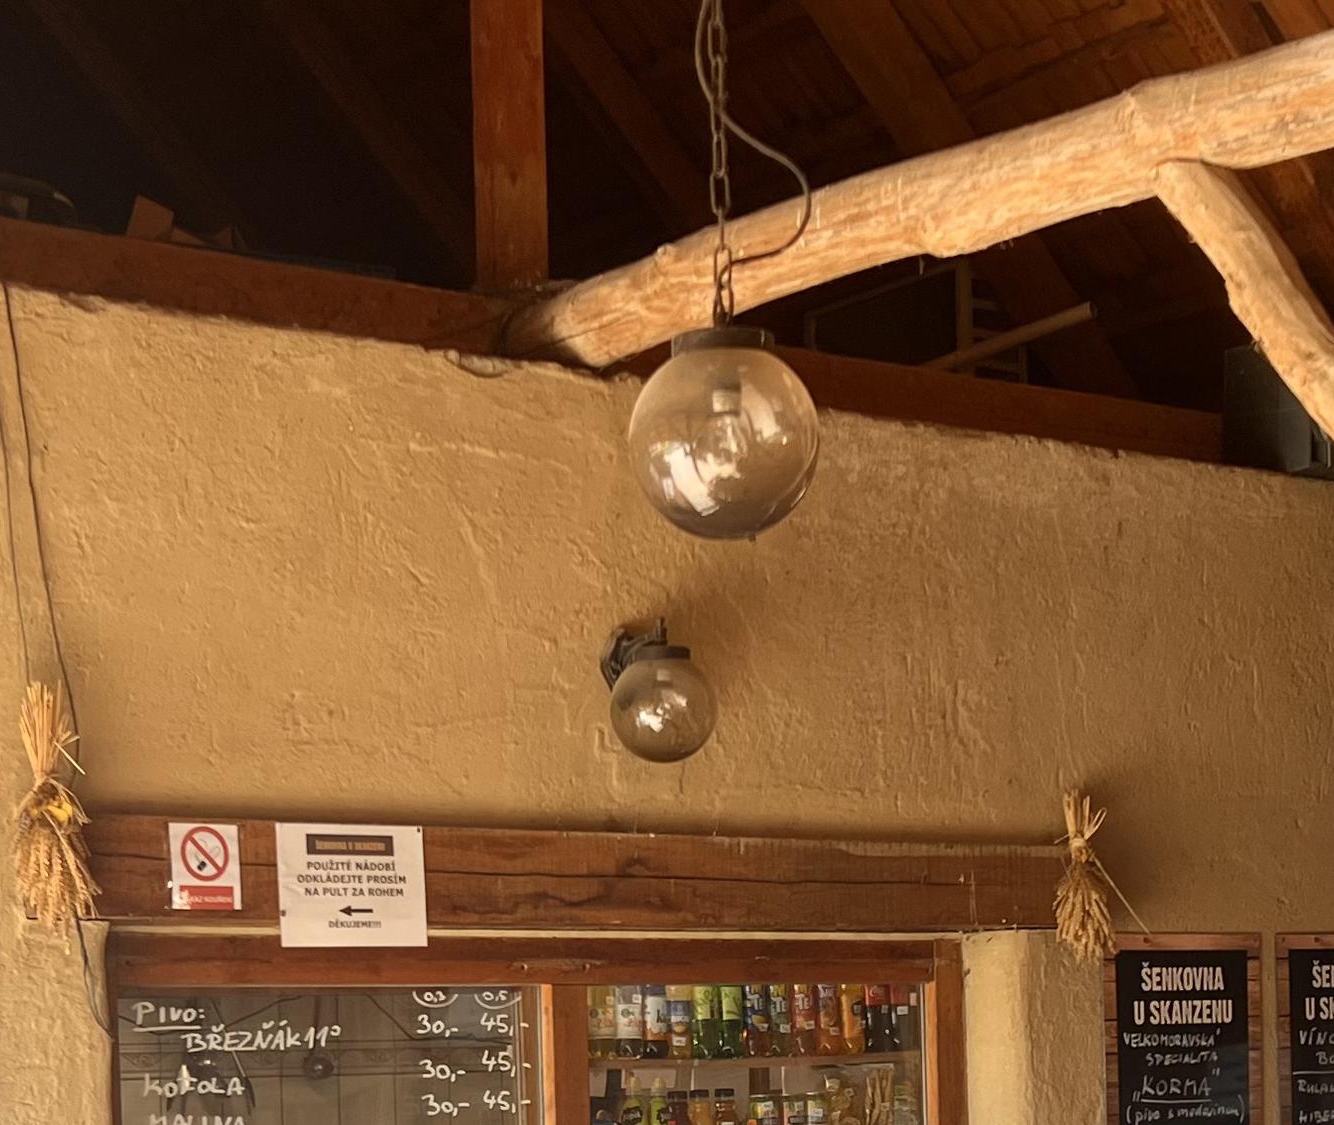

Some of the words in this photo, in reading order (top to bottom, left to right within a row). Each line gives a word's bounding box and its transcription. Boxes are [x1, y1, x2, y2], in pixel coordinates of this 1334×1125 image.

[307, 859, 351, 871] POUŽITÉ
[355, 860, 396, 871] NÁDOBÍ
[297, 872, 364, 884] ODKLÁDEJTE
[366, 874, 407, 884] PROSÍM
[305, 887, 320, 896] NA
[322, 887, 348, 896] PULT
[352, 888, 366, 896] ZA
[368, 888, 404, 897] ROHEM
[1141, 961, 1225, 991] ŠENKOVNA
[482, 990, 509, 1002] 0,5
[132, 1001, 205, 1026] PIVO:
[1133, 1001, 1145, 1025] U
[1149, 999, 1233, 1024] SKANZENU
[1305, 997, 1315, 1021] U
[180, 1019, 301, 1052] BŘEZŇÁK
[416, 1014, 459, 1037] 30,-
[1123, 1027, 1221, 1047] VELKOMORAVSKÁ
[1145, 1050, 1218, 1067] SPECIALITA
[142, 1073, 246, 1098] KOFOLA
[419, 1059, 466, 1082] 30,-
[421, 1094, 470, 1117] 30,-
